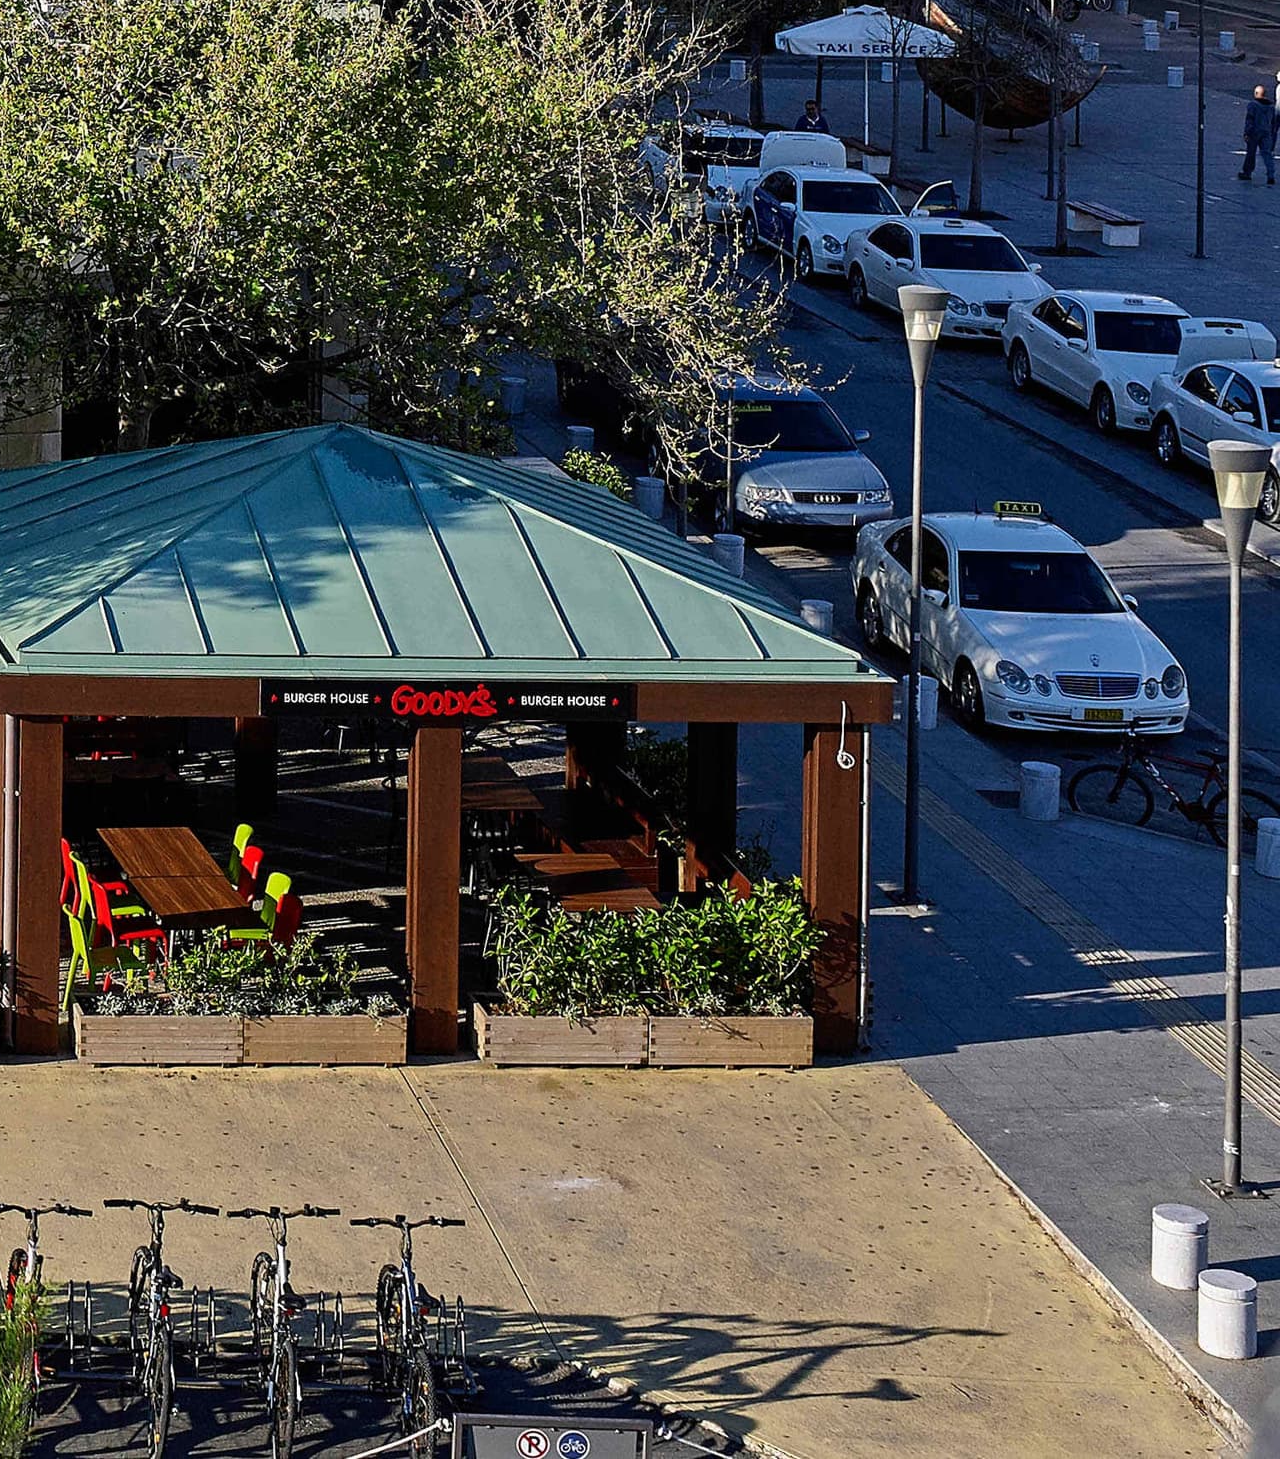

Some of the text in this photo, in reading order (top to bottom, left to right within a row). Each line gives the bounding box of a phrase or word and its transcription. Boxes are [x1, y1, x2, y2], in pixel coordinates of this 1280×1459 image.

[816, 43, 853, 53] TAXI
[1004, 503, 1034, 512] TAXI
[283, 692, 327, 704] BURGER
[330, 692, 369, 704] HOUSE
[521, 695, 564, 707] BURGER
[567, 695, 606, 707] HOUSE
